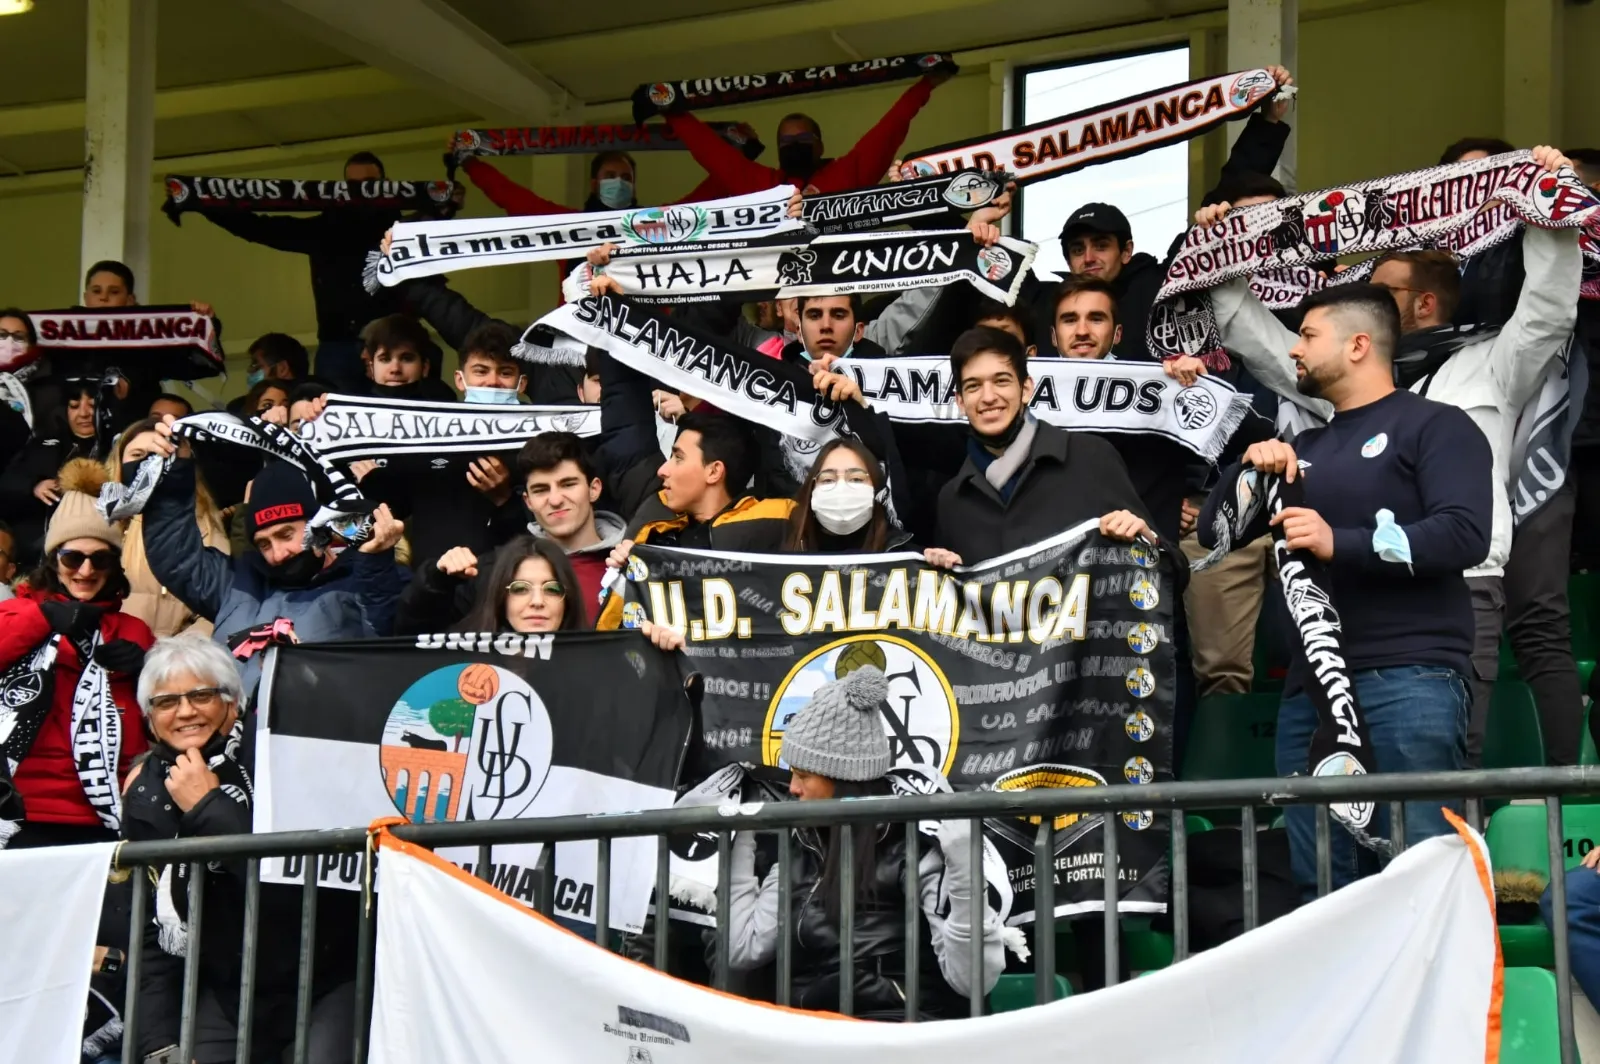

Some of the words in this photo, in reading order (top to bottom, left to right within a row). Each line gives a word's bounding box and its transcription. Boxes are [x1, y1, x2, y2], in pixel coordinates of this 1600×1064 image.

[1012, 83, 1226, 170] SALAMANCA
[193, 177, 282, 200] LOCOS
[292, 180, 309, 201] X
[318, 180, 350, 201] LA
[711, 202, 789, 229] 192
[801, 188, 938, 223] LAMANCA
[619, 246, 658, 255] DEPORTIVA
[659, 243, 703, 253] SALAMANCA
[707, 241, 731, 250] DESDE
[1167, 234, 1275, 284] eportiva
[634, 258, 754, 290] HALA
[832, 239, 960, 277] UNIÓN
[834, 284, 855, 293] UNIÓN
[857, 281, 896, 290] DEPORTIVA
[897, 278, 939, 288] SALAMANCA
[657, 294, 687, 304] CORAZÓN
[687, 294, 721, 303] UNIONISTA
[41, 317, 207, 341] SALAMANCA
[572, 295, 799, 416] SALAMANCA
[1074, 376, 1167, 415] UDS
[207, 420, 228, 434] NO
[323, 410, 541, 441] SALAMANCA
[1077, 547, 1137, 567] CHAR
[648, 577, 752, 641] U.D.
[781, 567, 1091, 644] SALAMANCA
[415, 632, 555, 661] UNION
[981, 714, 1017, 731] U.D.
[1246, 720, 1276, 738] 12
[108, 751, 117, 773] NO
[960, 753, 1017, 776] HALA
[1022, 726, 1095, 762] UNION
[1563, 838, 1595, 859] 10
[1128, 869, 1139, 881] !!
